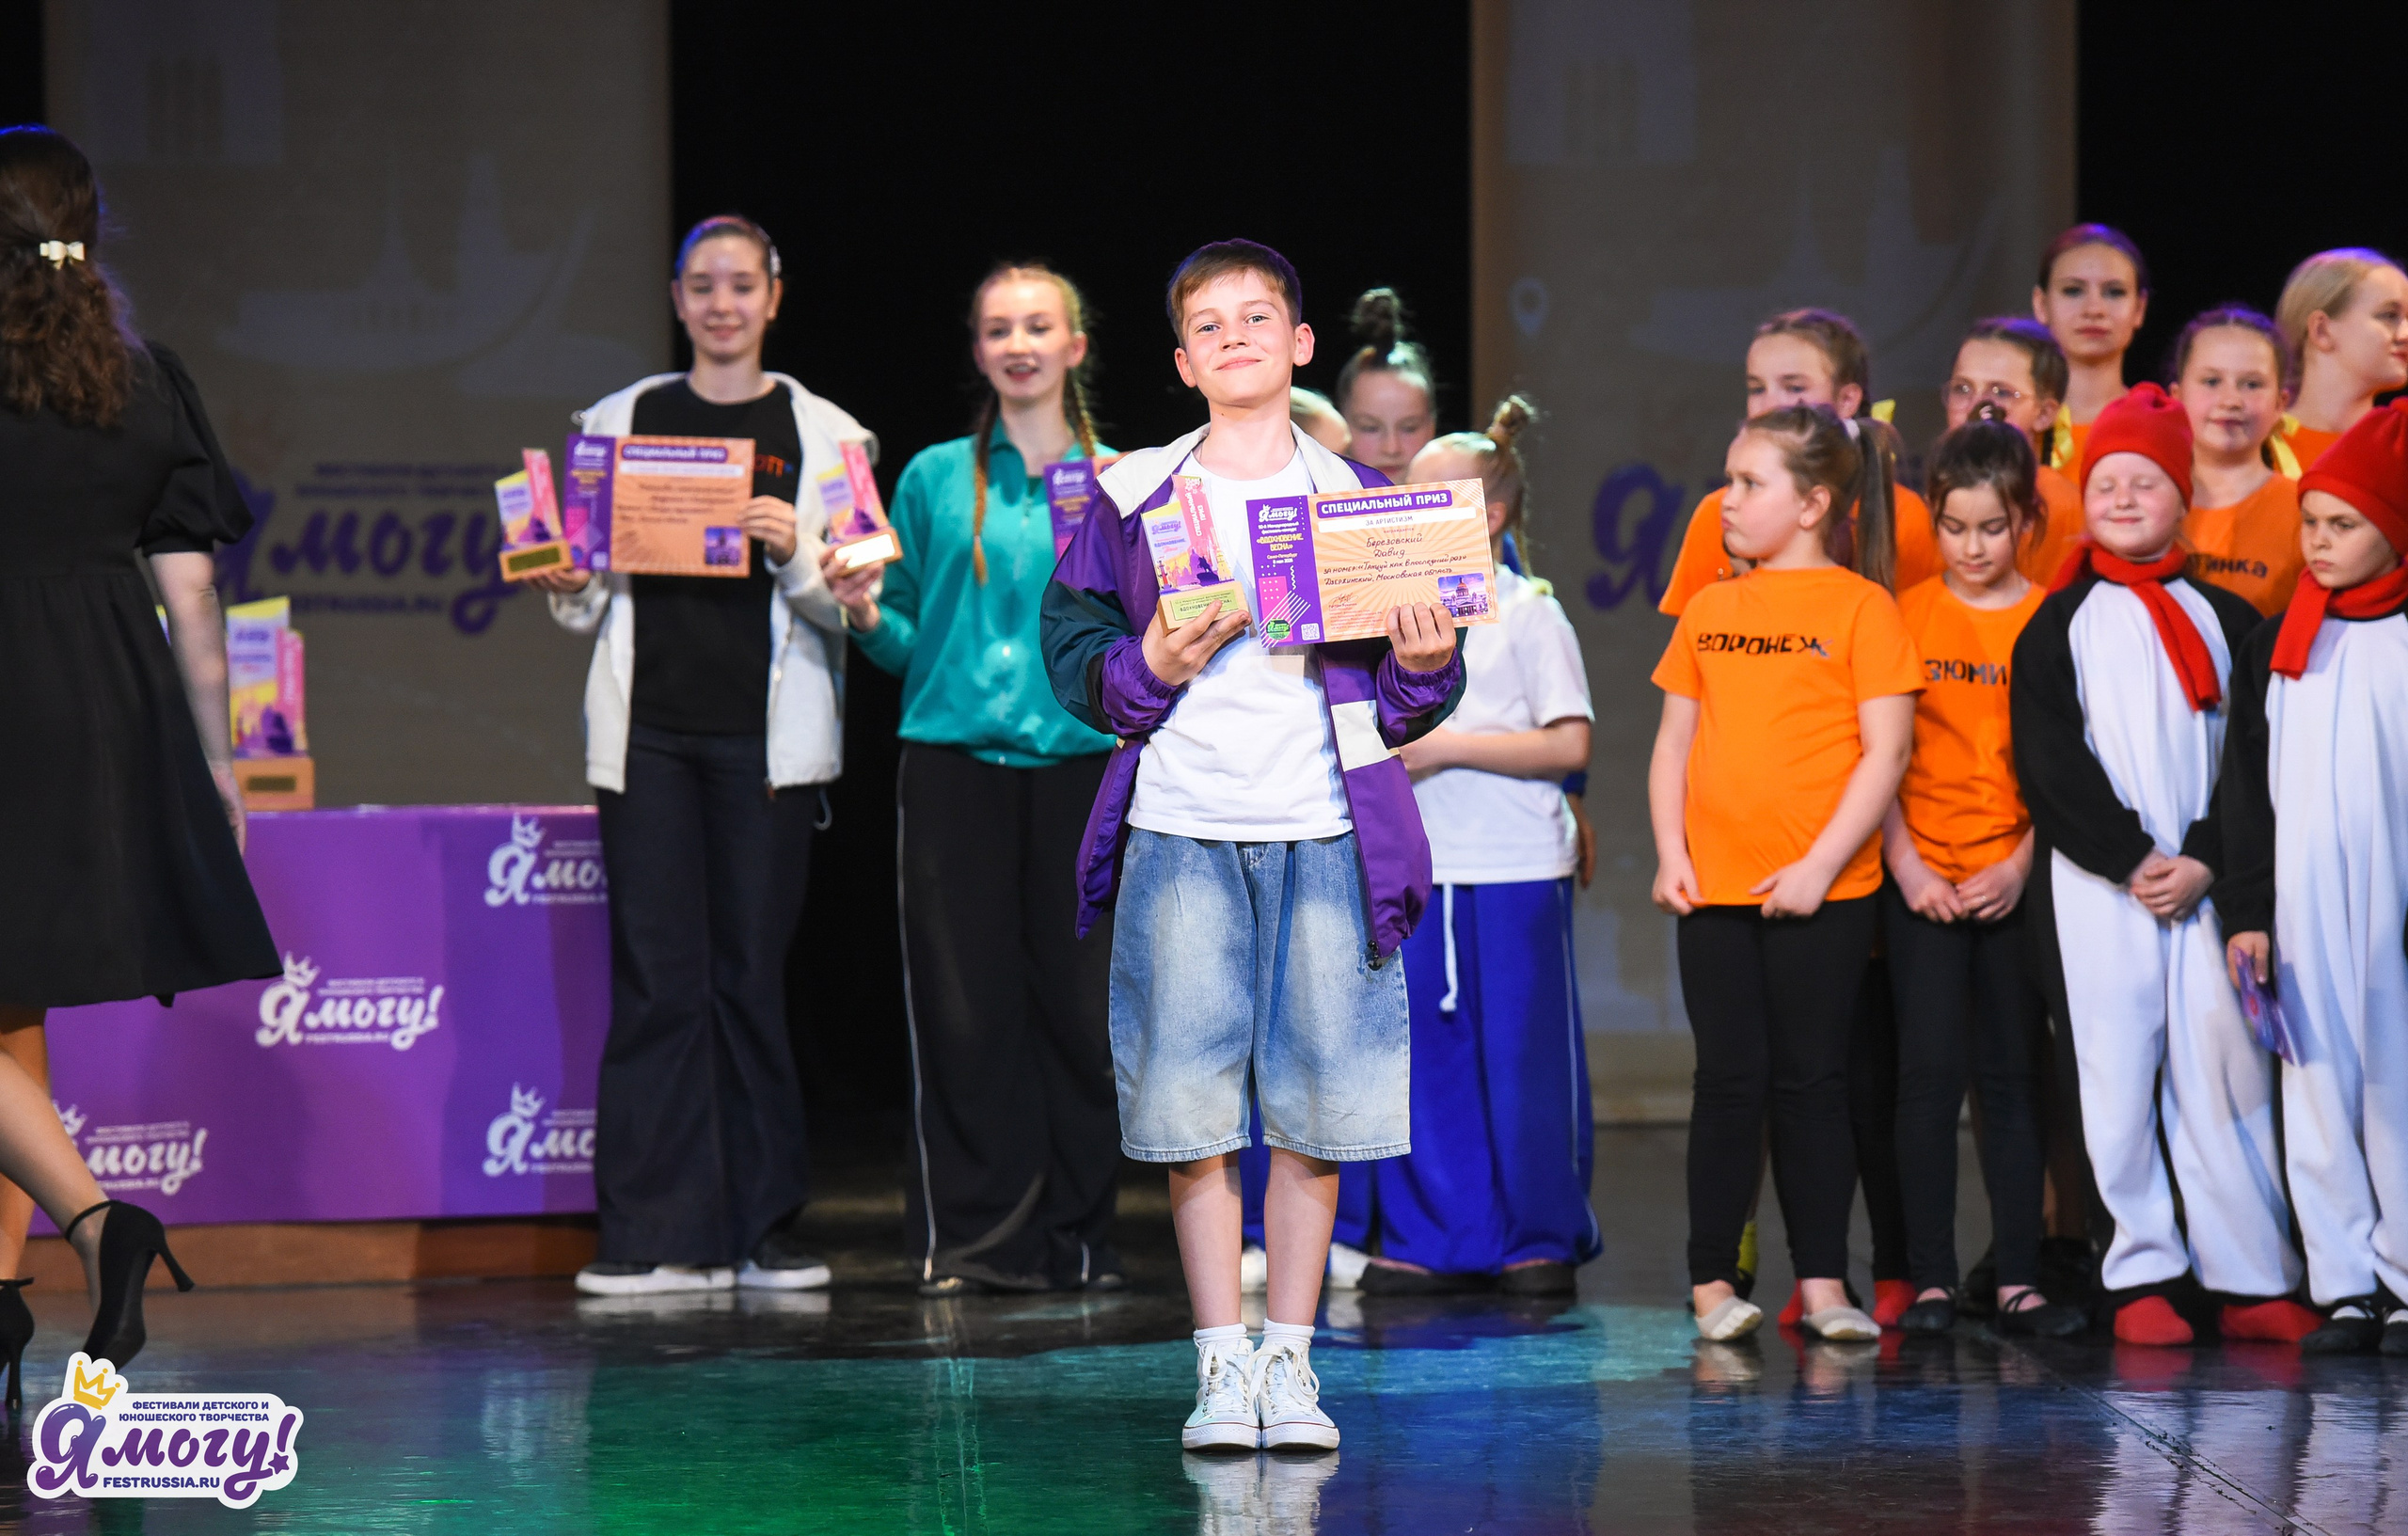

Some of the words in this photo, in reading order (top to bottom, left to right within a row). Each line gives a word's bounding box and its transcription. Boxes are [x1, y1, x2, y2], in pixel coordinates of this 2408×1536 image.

[1321, 493, 1412, 515] СПЕЦИАЛЬНЫЙ
[1416, 493, 1448, 505] ПРИЗ
[1375, 515, 1413, 525] АРТИСТИЗМ
[1366, 533, 1423, 548] Березовский
[1373, 547, 1405, 559] Давид
[270, 509, 524, 635] могу
[1697, 633, 1832, 659] ВОРОНЕЖ
[1925, 659, 2007, 686] ЗЮМИ
[484, 842, 537, 907] Я
[255, 981, 310, 1048] Я
[304, 985, 444, 1051] могу!
[482, 1112, 535, 1177] Я
